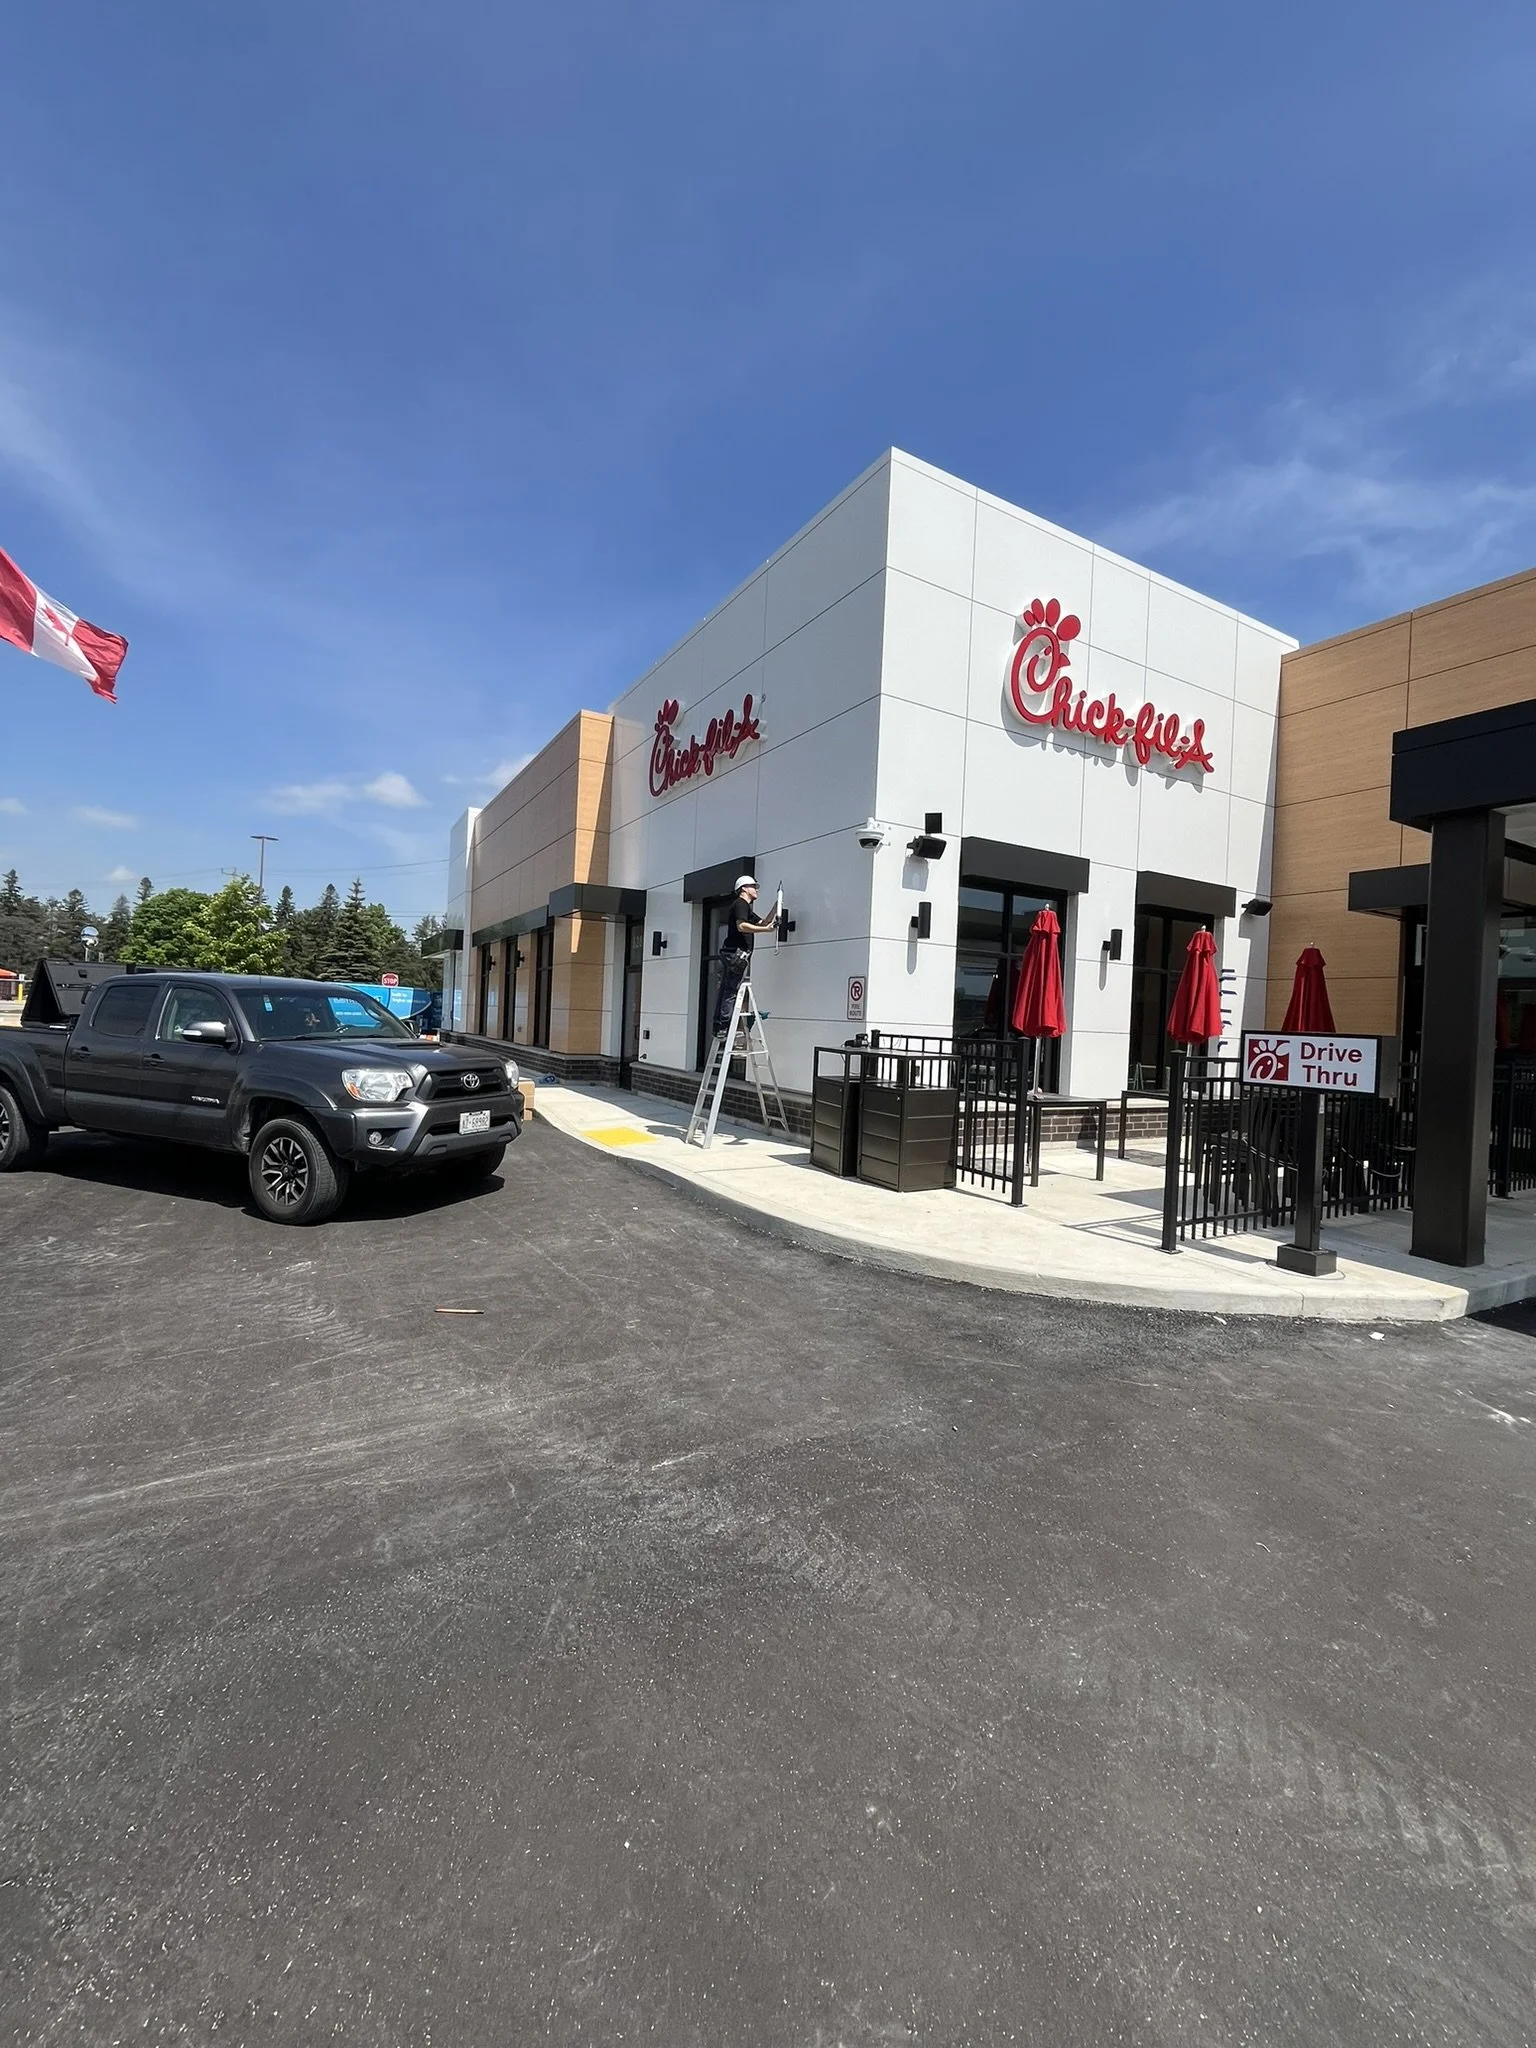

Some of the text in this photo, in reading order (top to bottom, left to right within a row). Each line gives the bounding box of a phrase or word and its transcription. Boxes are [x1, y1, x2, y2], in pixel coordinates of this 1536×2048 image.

[1010, 598, 1215, 773] Chick-fil-A
[649, 693, 760, 797] Chick-fil-A
[383, 977, 397, 985] STOP
[1300, 1042, 1363, 1063] Drive
[1302, 1064, 1358, 1087] Thru
